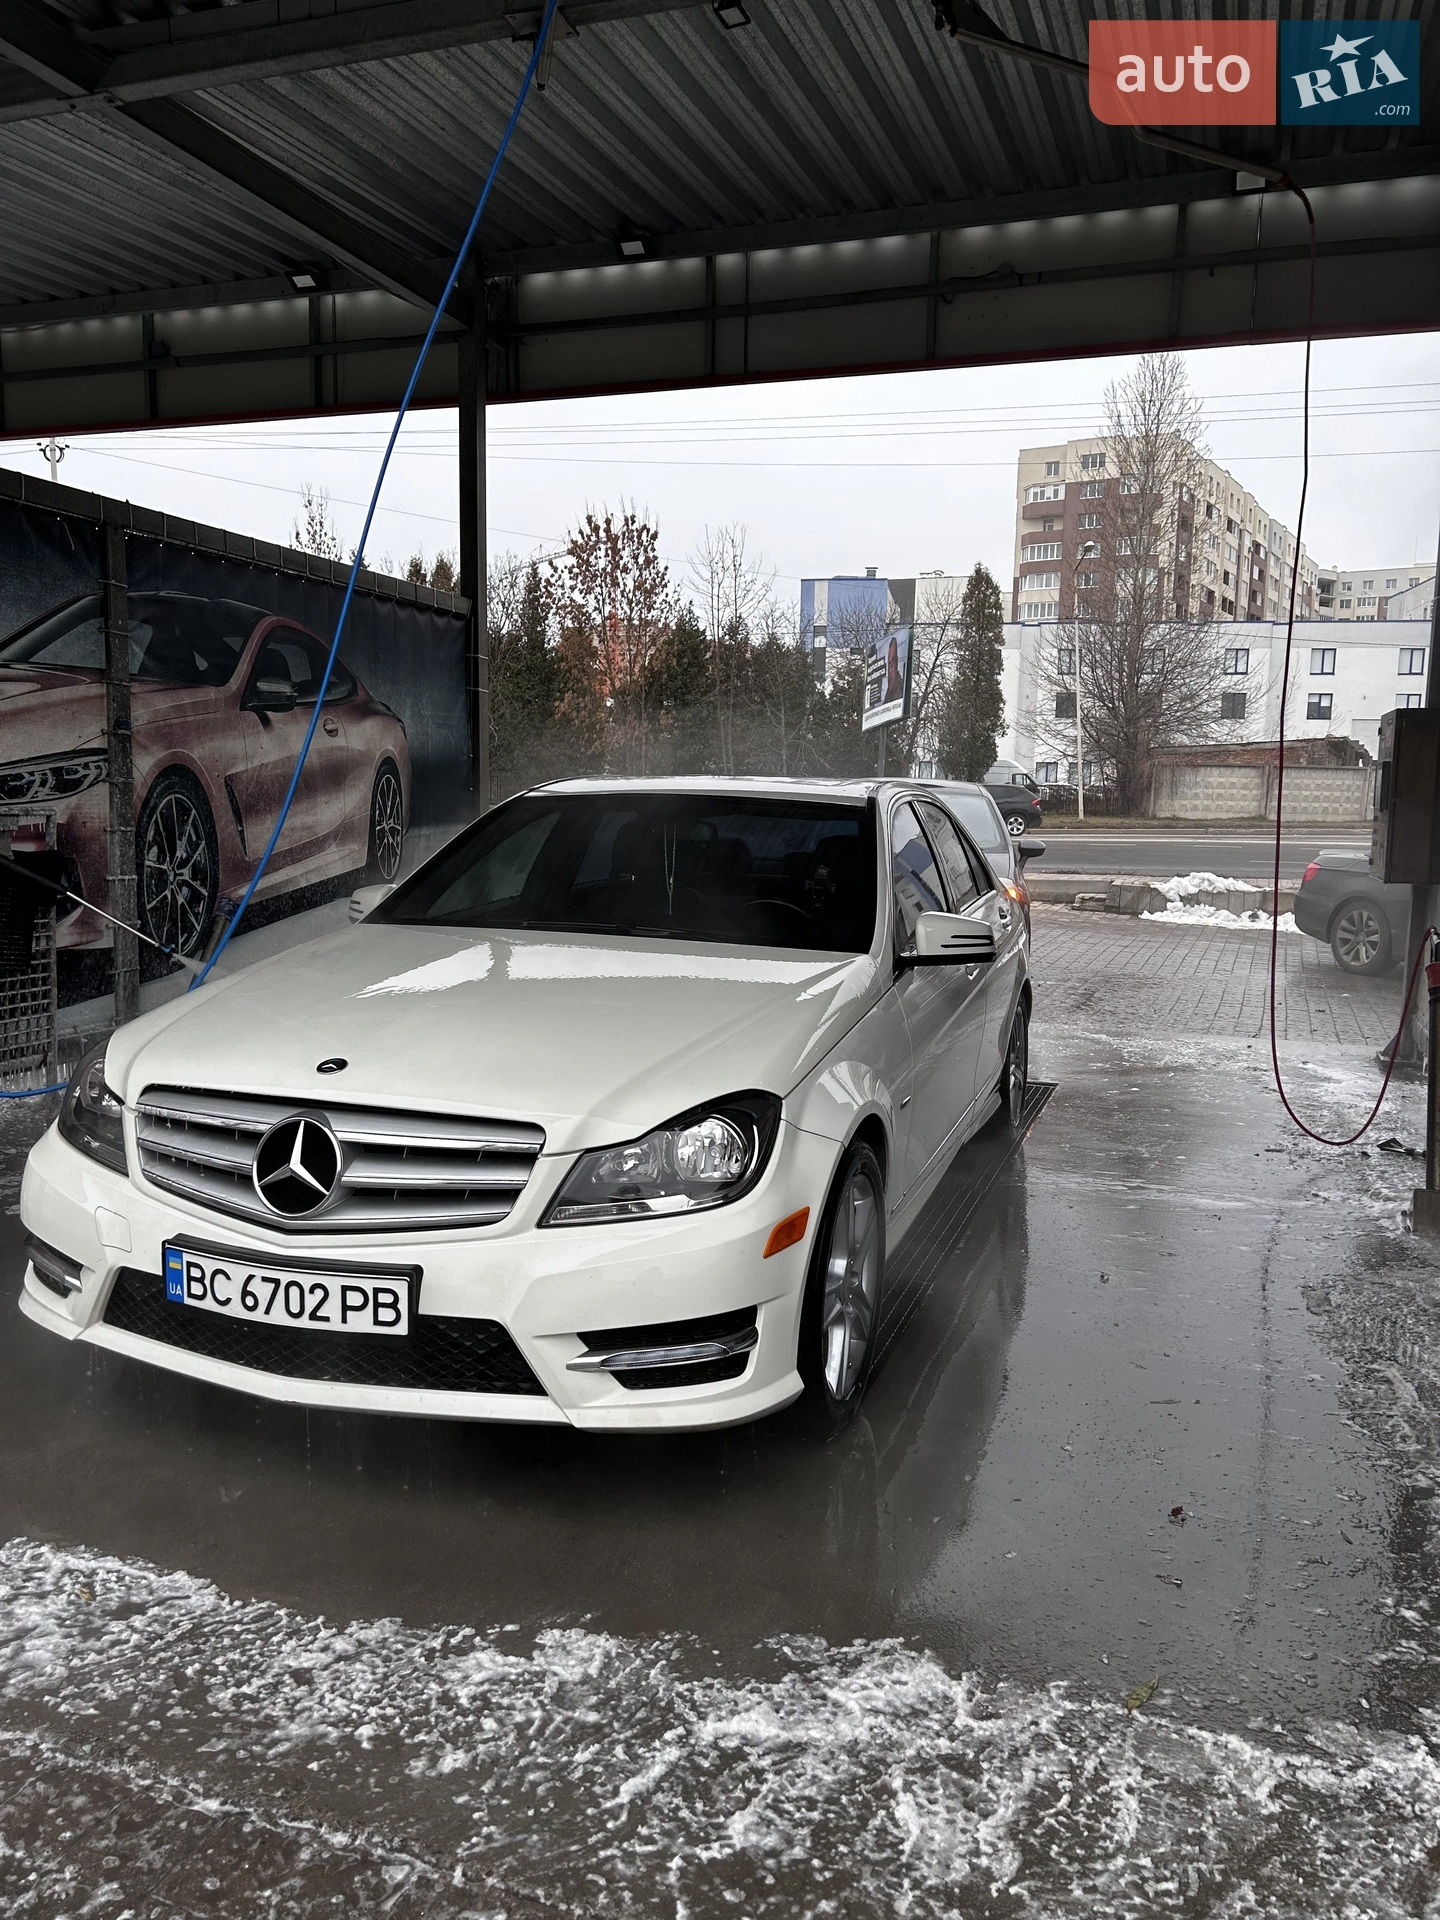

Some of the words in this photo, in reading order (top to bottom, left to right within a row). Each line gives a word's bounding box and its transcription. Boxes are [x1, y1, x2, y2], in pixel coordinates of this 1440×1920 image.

[169, 1282, 183, 1297] UA
[185, 1260, 233, 1307] BC
[240, 1273, 331, 1323] 6702
[340, 1284, 402, 1328] PB
